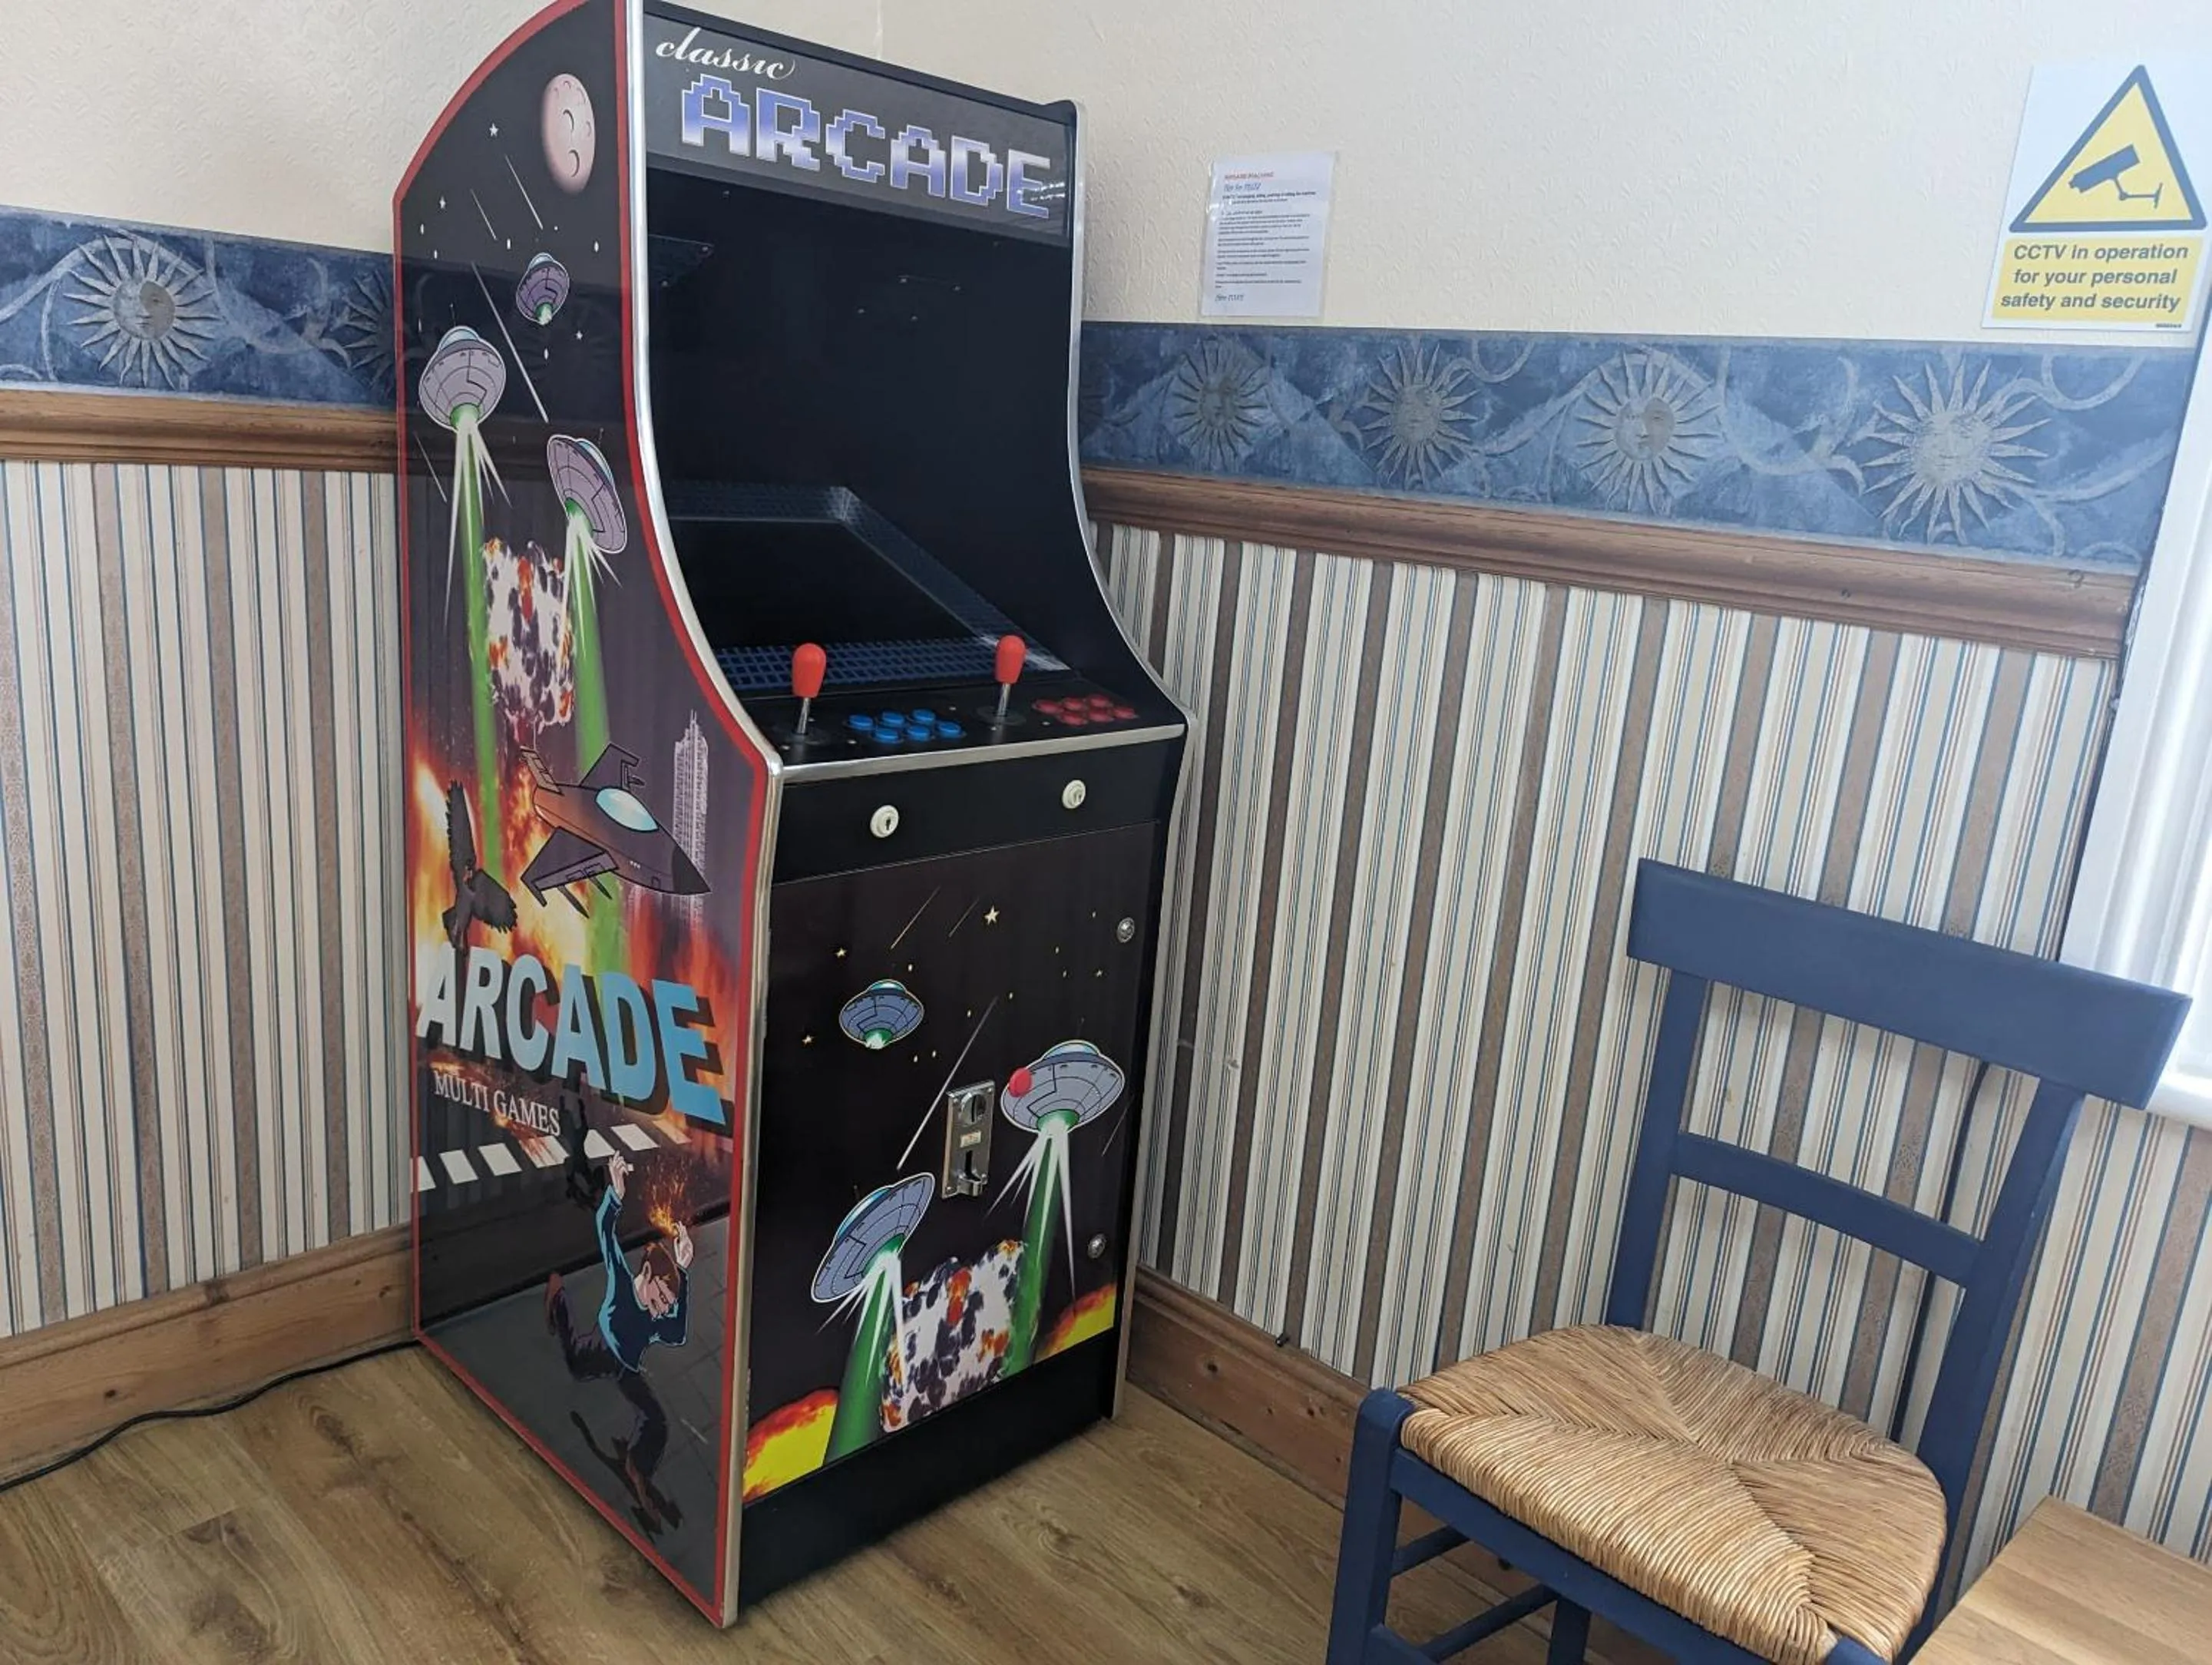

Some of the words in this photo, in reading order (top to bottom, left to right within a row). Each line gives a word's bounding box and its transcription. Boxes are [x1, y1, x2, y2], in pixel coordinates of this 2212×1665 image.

[656, 27, 795, 80] classic
[681, 72, 1052, 220] ARCADE
[2013, 244, 2067, 260] CCTV
[2071, 244, 2088, 260] in
[2094, 243, 2189, 263] operation
[2013, 269, 2039, 283] for
[2044, 272, 2087, 287] your
[2091, 268, 2177, 287] personal
[2001, 293, 2055, 311] safety
[2061, 293, 2097, 309] and
[2101, 294, 2181, 313] security
[415, 941, 726, 1125] ARCADE
[433, 1071, 491, 1114] MULTI
[493, 1091, 560, 1137] GAMES
